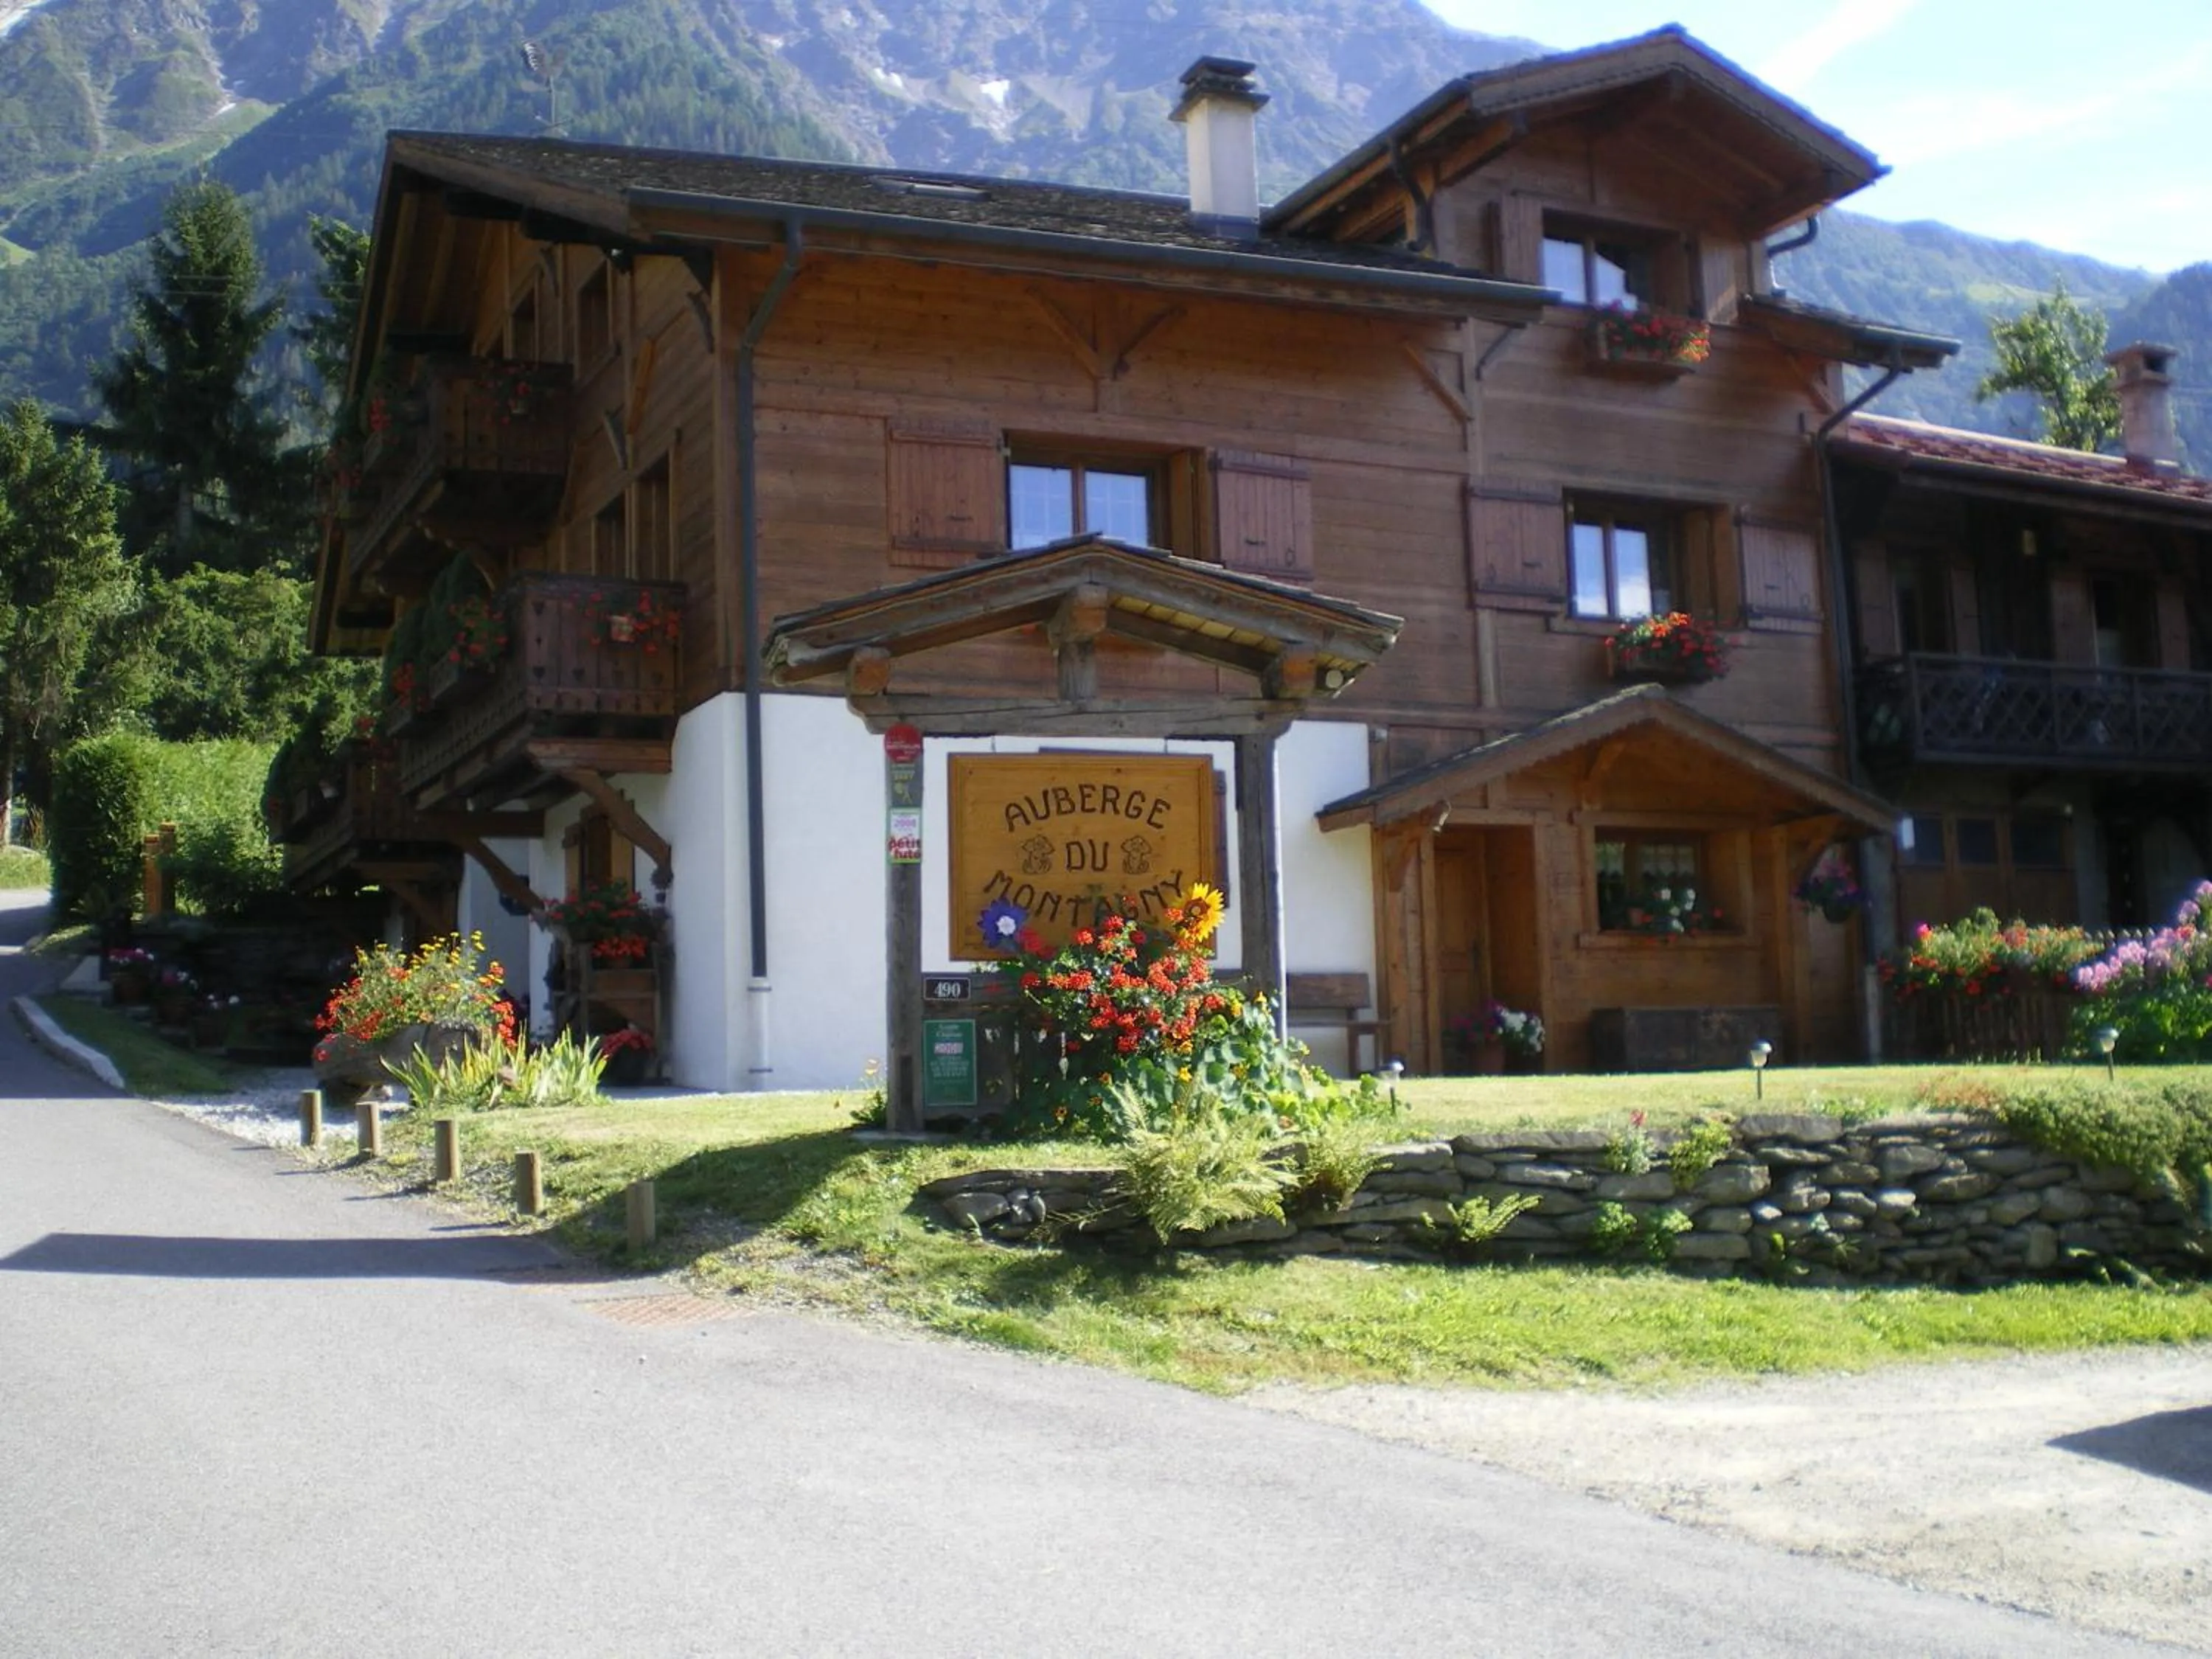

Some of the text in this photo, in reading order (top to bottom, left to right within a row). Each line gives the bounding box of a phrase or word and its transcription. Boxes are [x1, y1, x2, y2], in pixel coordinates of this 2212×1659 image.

[1004, 783, 1172, 832] AUBERGE
[1065, 838, 1109, 872] DU
[933, 981, 961, 998] 490
